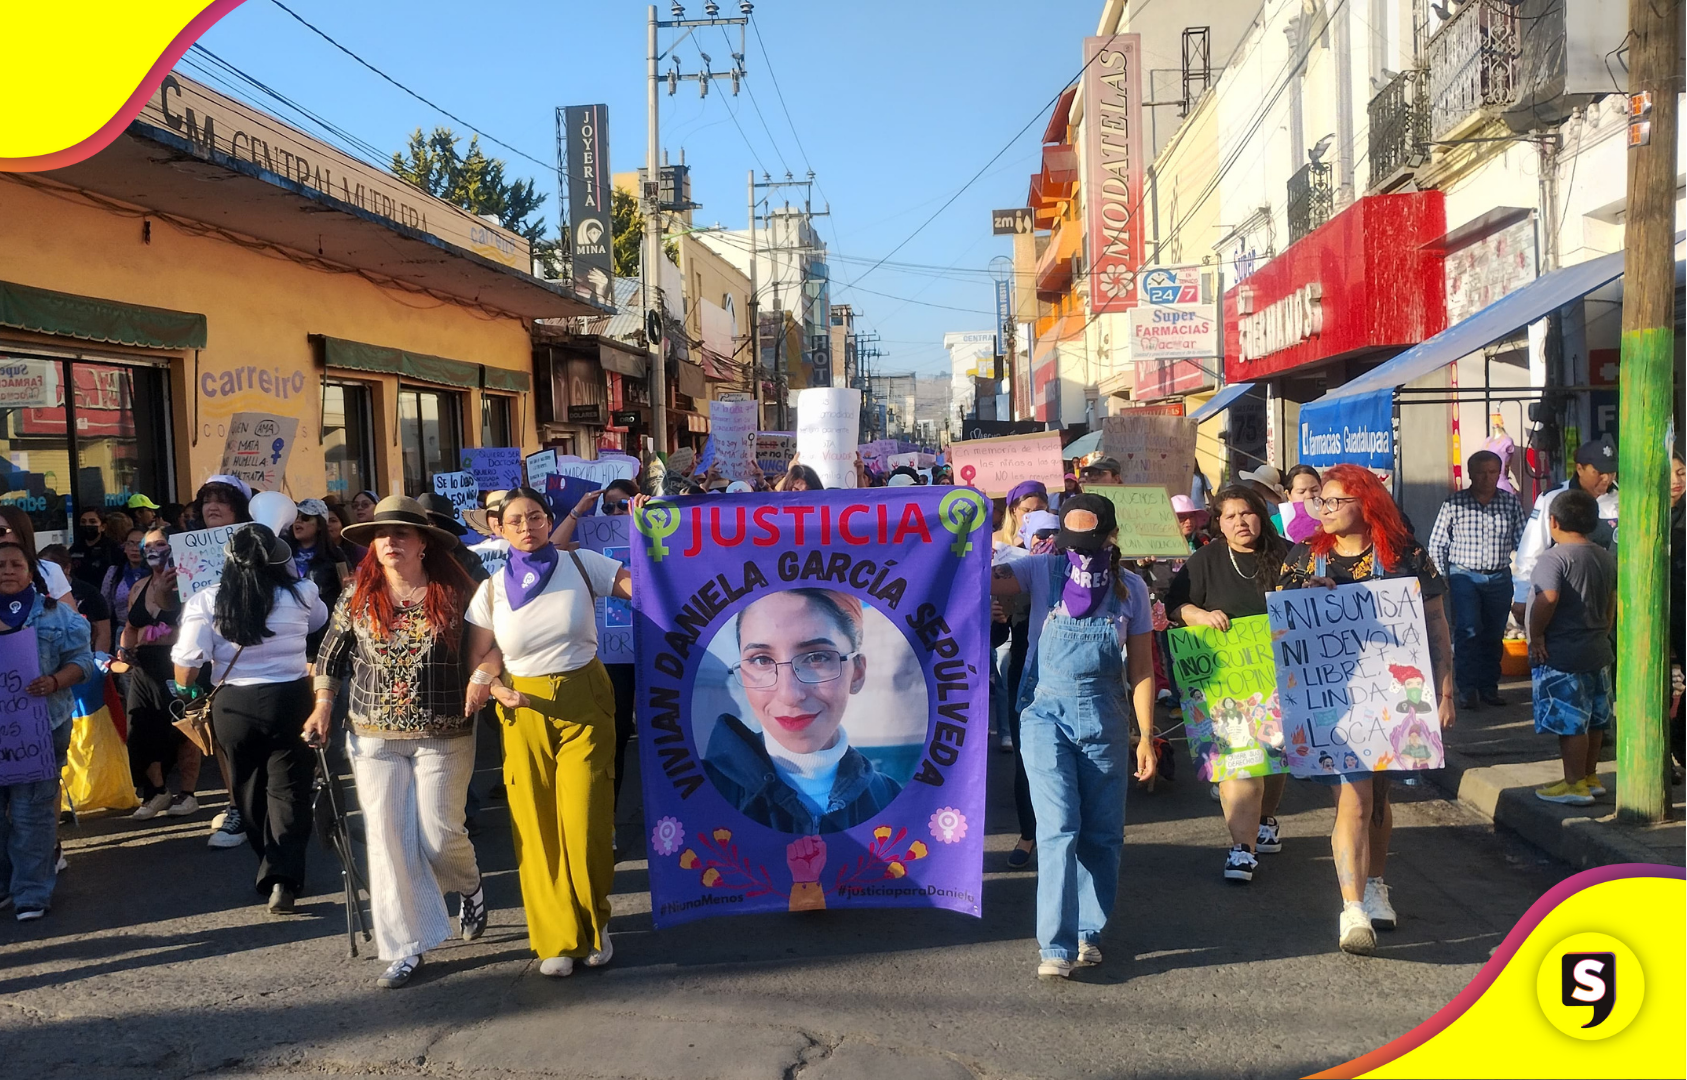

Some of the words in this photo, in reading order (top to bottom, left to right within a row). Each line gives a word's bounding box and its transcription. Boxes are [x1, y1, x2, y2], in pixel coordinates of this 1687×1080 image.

[1099, 48, 1130, 261] MODATELAS
[576, 245, 606, 255] MINA
[1152, 290, 1173, 302] 24
[1152, 310, 1196, 324] Super
[1136, 322, 1210, 337] FARMACIAS
[202, 366, 304, 399] carreiro
[257, 424, 274, 434] AMA
[238, 440, 260, 451] MATA
[726, 441, 737, 450] soy
[780, 438, 789, 448] el
[1310, 427, 1341, 456] farmacias
[955, 447, 970, 458] En
[488, 458, 520, 468] DOCTORA
[602, 464, 624, 481] HOY
[758, 459, 788, 472] NINGU
[980, 458, 994, 468] las
[436, 476, 448, 488] SE
[996, 470, 1008, 482] NO
[1159, 512, 1172, 522] NO
[582, 518, 628, 546] POR
[684, 502, 932, 558] JUSTICIA
[1124, 539, 1144, 550] UNA
[1078, 554, 1092, 570] Y
[777, 549, 908, 610] GARCÍA
[1064, 562, 1108, 588] LIBRES
[192, 579, 212, 592] por
[1284, 597, 1321, 630] NI
[1325, 586, 1418, 624] SUMISA
[654, 560, 769, 680] DANIELA
[602, 632, 634, 654] POR
[1171, 630, 1200, 654] MI
[1281, 640, 1309, 666] NI
[1316, 622, 1420, 659] DEVOTA
[1179, 655, 1211, 677] NO
[1212, 644, 1274, 668] QUIER
[904, 602, 978, 787] SEPÚLVEDA
[1188, 676, 1222, 698] TU
[1306, 682, 1388, 710] LINDA
[1306, 716, 1388, 748] LOCA
[650, 684, 705, 800] VIVIAN
[660, 894, 744, 917] #NiunaMenos
[838, 884, 976, 903] #justiciaparaDaniela
